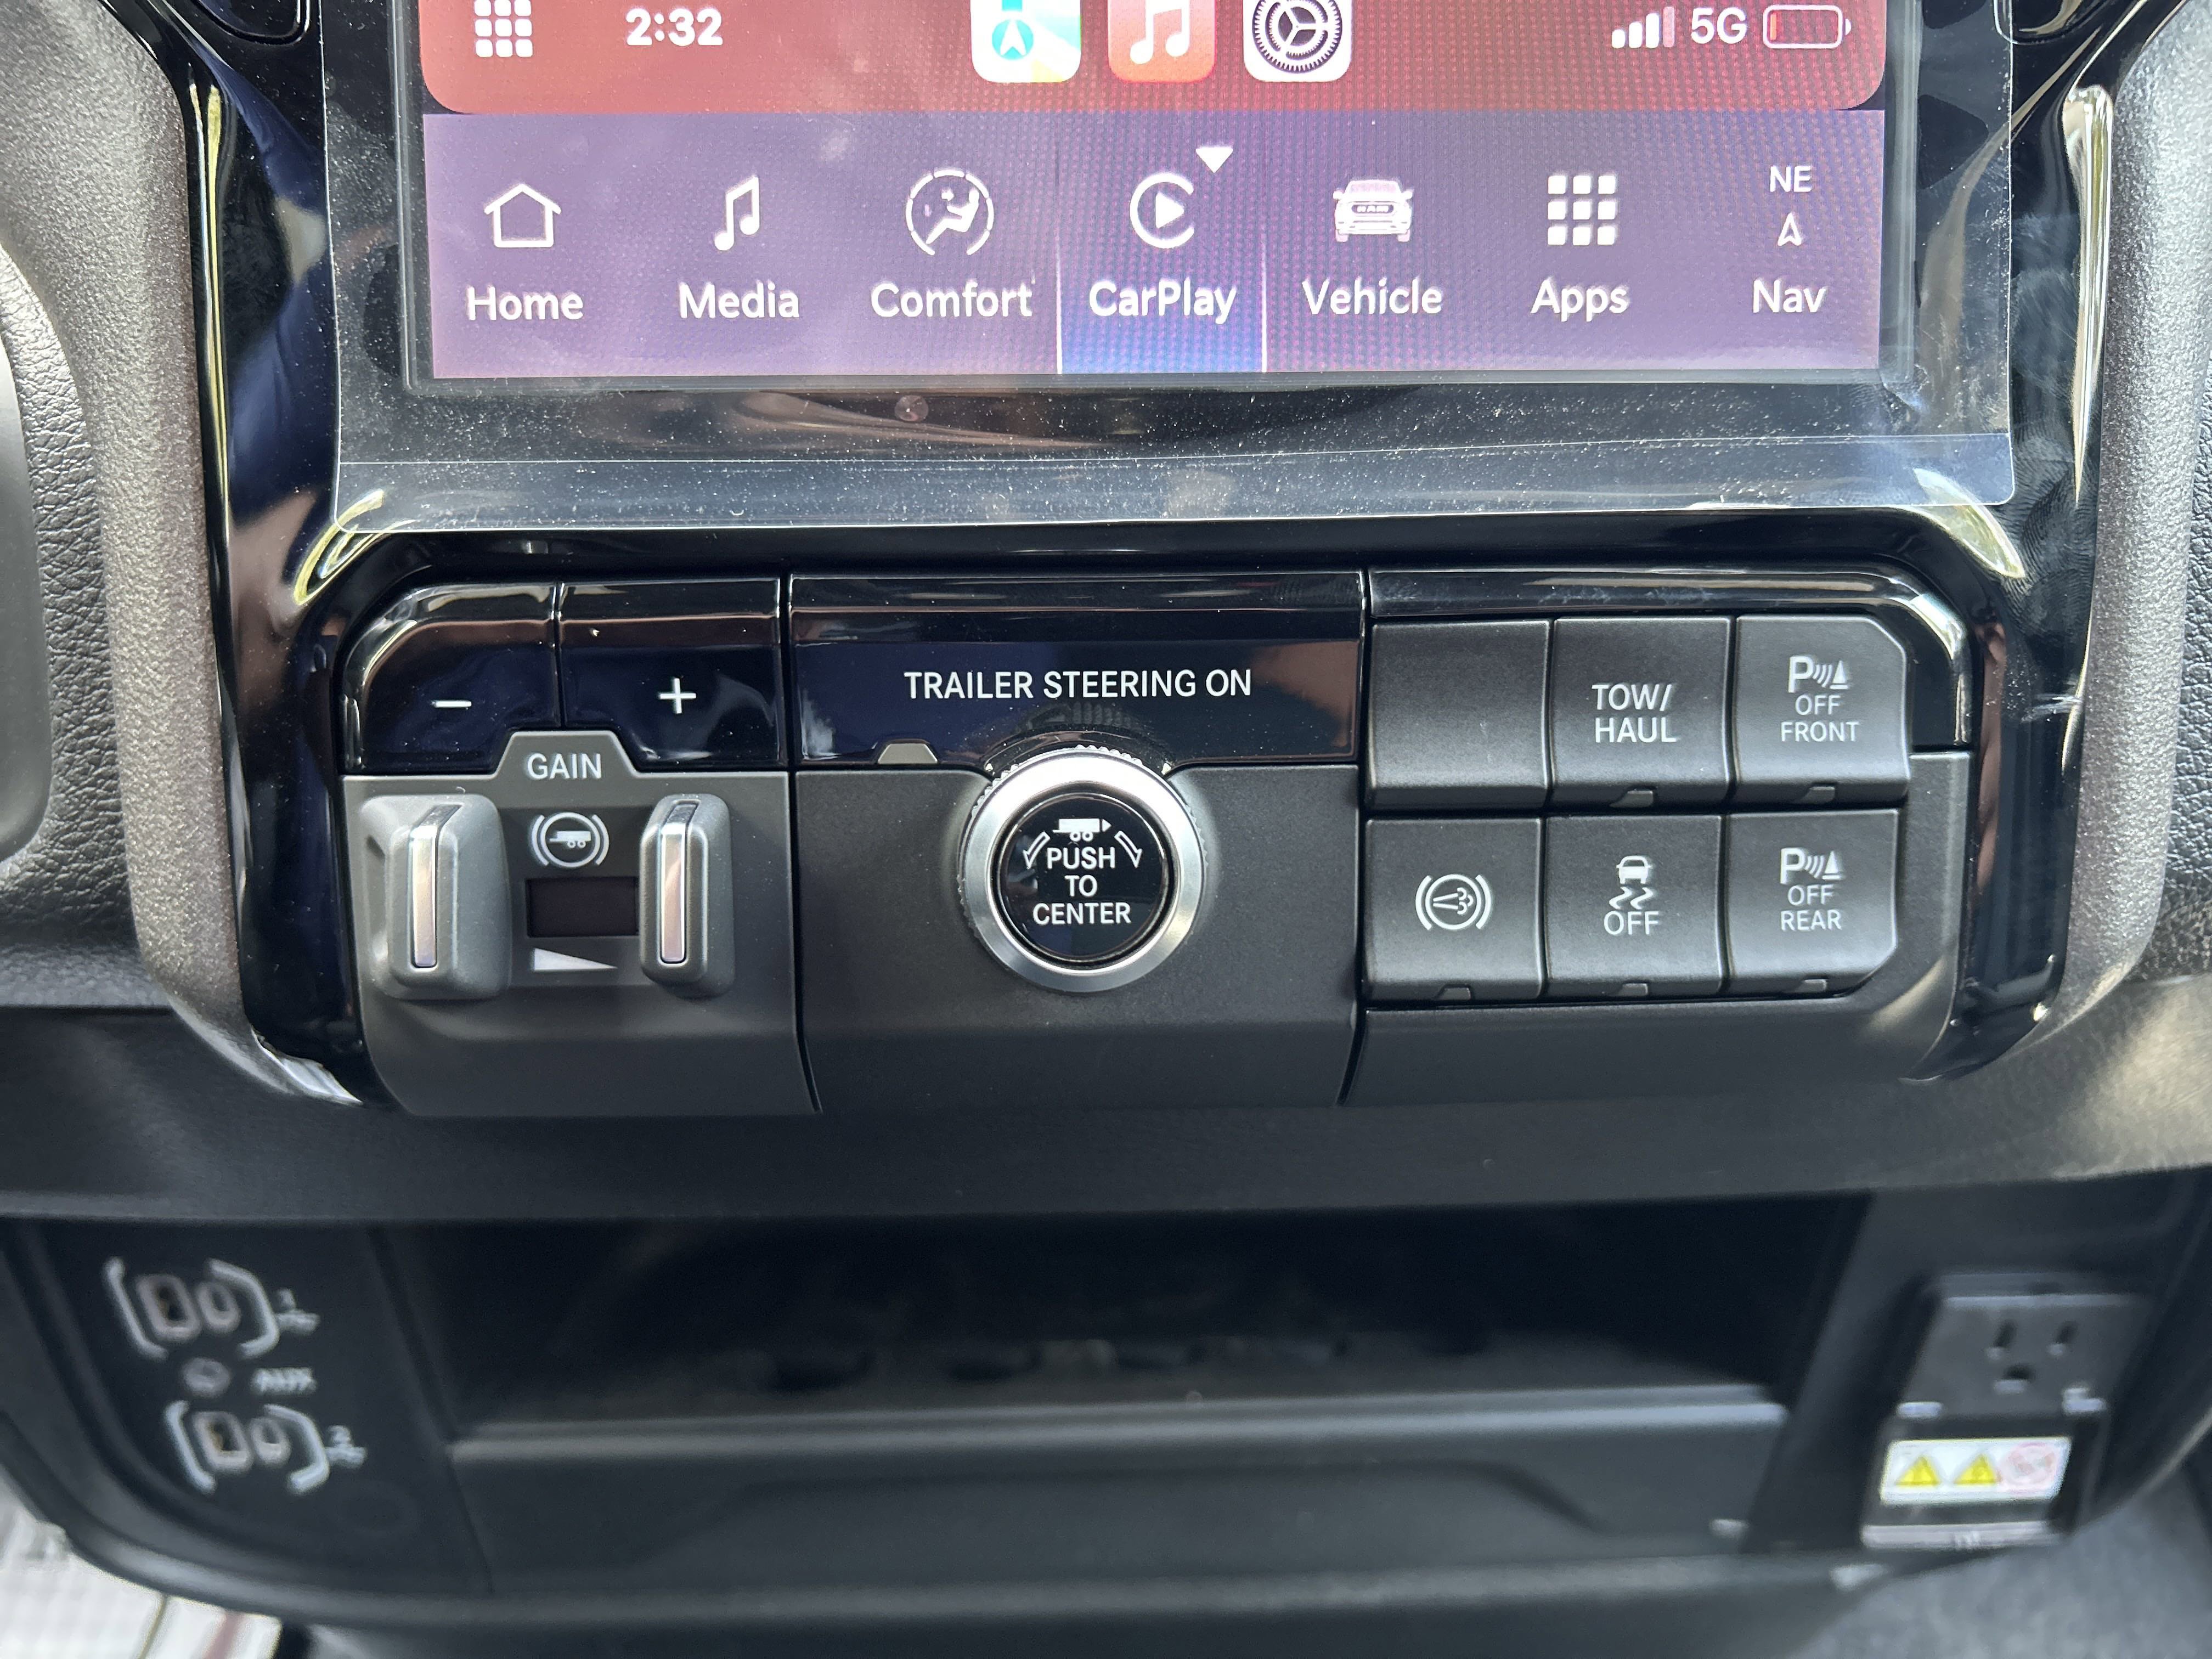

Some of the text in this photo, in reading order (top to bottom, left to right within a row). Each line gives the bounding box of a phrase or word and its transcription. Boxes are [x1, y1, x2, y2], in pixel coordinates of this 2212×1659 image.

[625, 7, 724, 47] 2:32
[1690, 6, 1748, 45] 5G
[1769, 165, 1814, 193] NE
[466, 285, 584, 321] Home
[678, 279, 800, 319] Media
[870, 281, 1032, 318] Comfort
[1088, 276, 1238, 325] CarPlay
[1301, 275, 1443, 315] Vehicle
[1530, 276, 1630, 323] Apps
[1752, 277, 1826, 314] Nav
[903, 668, 1251, 699] TRAILER STEERING ON
[1591, 683, 1673, 712] TOW/
[1795, 694, 1841, 716] OFF
[1595, 716, 1678, 743] HAUL
[1780, 720, 1860, 743] FRONT
[527, 752, 602, 780] GAIN
[1046, 845, 1116, 870] PUSH
[1064, 874, 1098, 898] TO
[1787, 884, 1834, 906] OFF
[1032, 901, 1132, 926] CENTER
[1603, 910, 1660, 936] OFF
[1780, 909, 1843, 932] REAR
